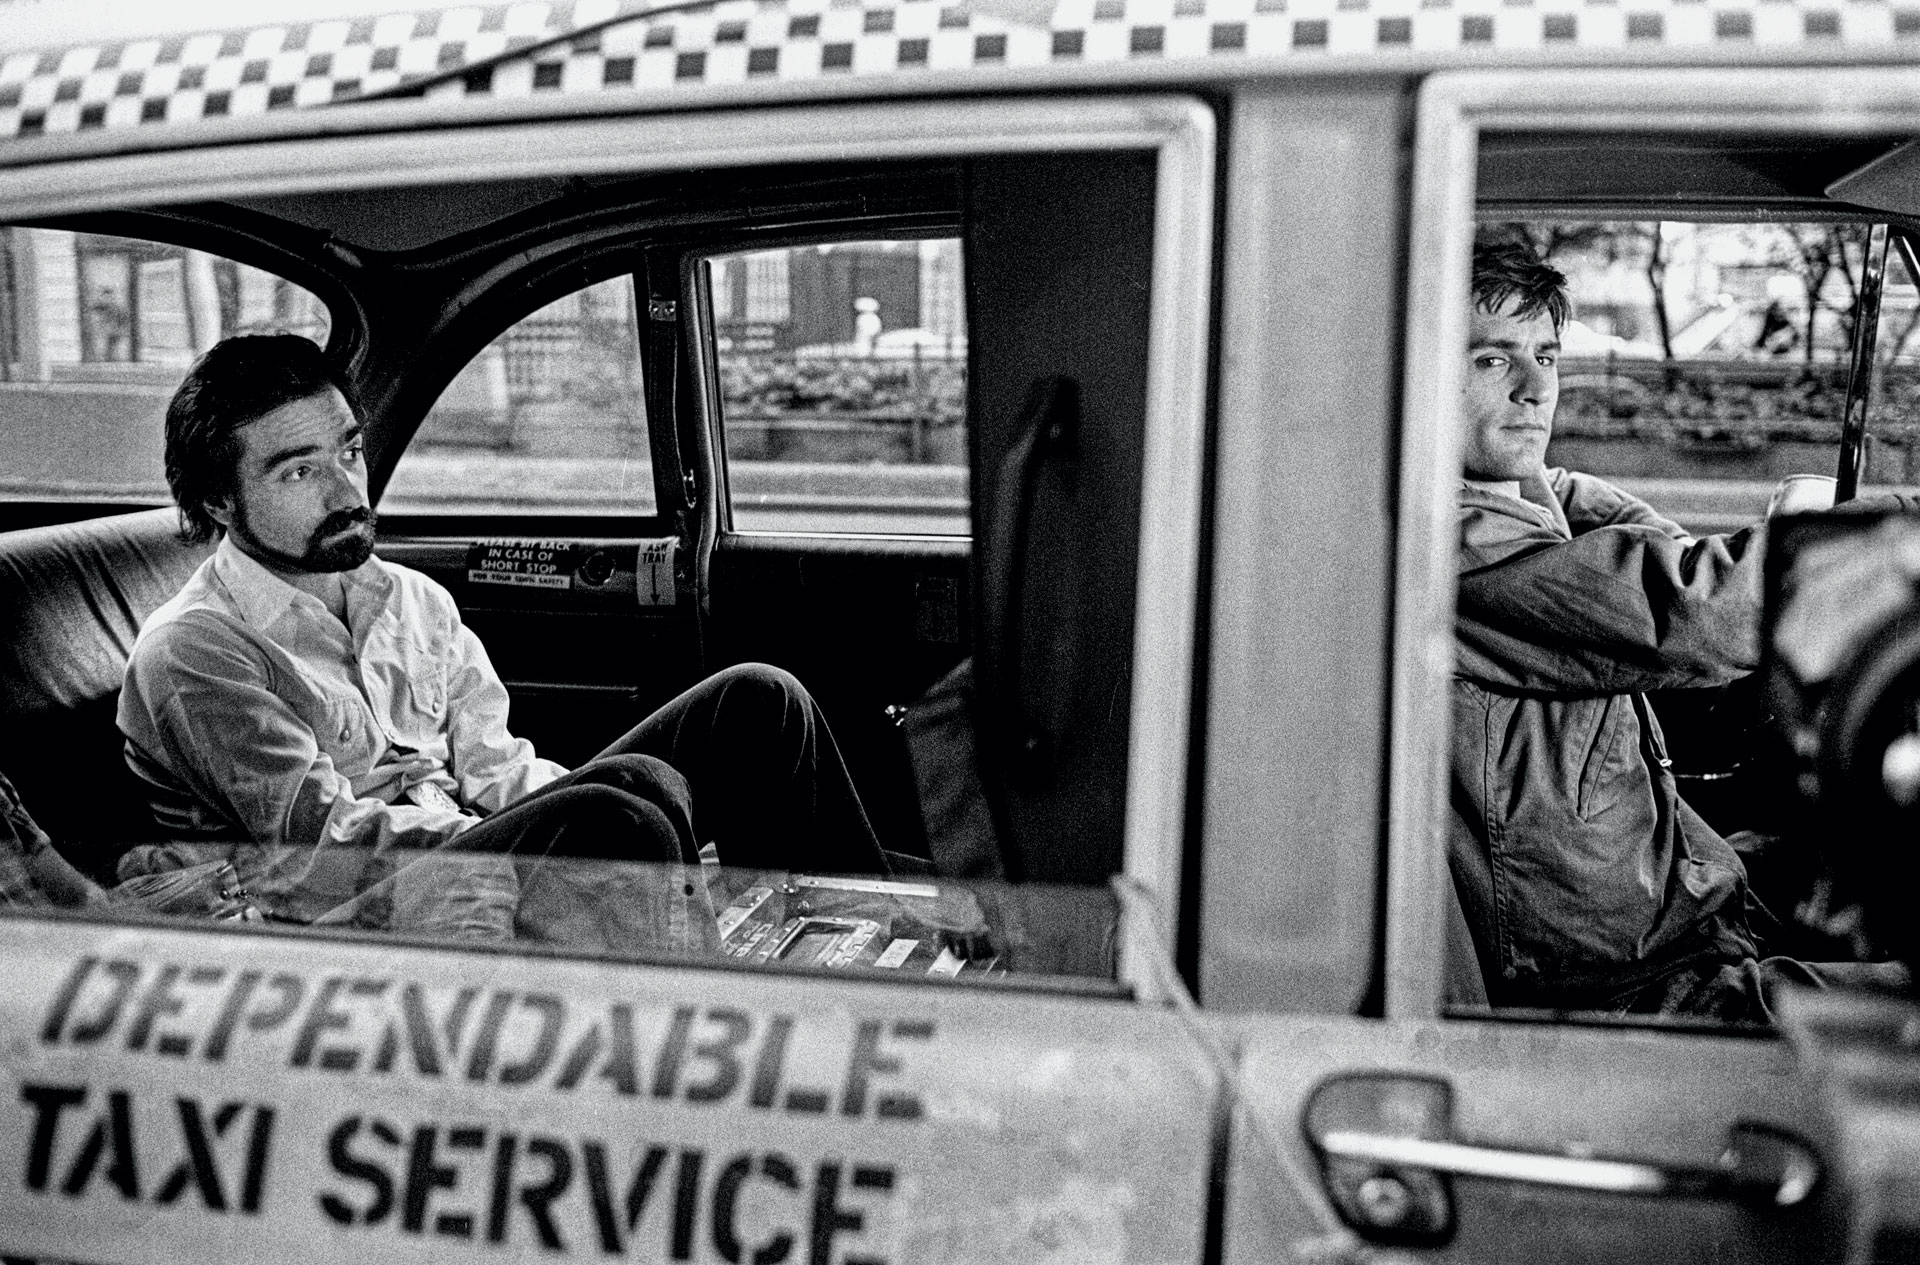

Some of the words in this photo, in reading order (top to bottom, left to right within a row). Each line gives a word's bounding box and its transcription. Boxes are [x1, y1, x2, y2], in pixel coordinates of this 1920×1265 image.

[540, 541, 570, 551] BACK
[488, 548, 502, 558] IN
[505, 549, 534, 560] CASE
[538, 551, 554, 561] OF
[643, 552, 667, 564] TRAY
[481, 559, 520, 571] SHORT
[526, 562, 557, 574] STOP
[38, 955, 937, 1121] DEPENDABLE
[20, 1081, 277, 1216] TAXI
[316, 1114, 898, 1265] SERVICE
